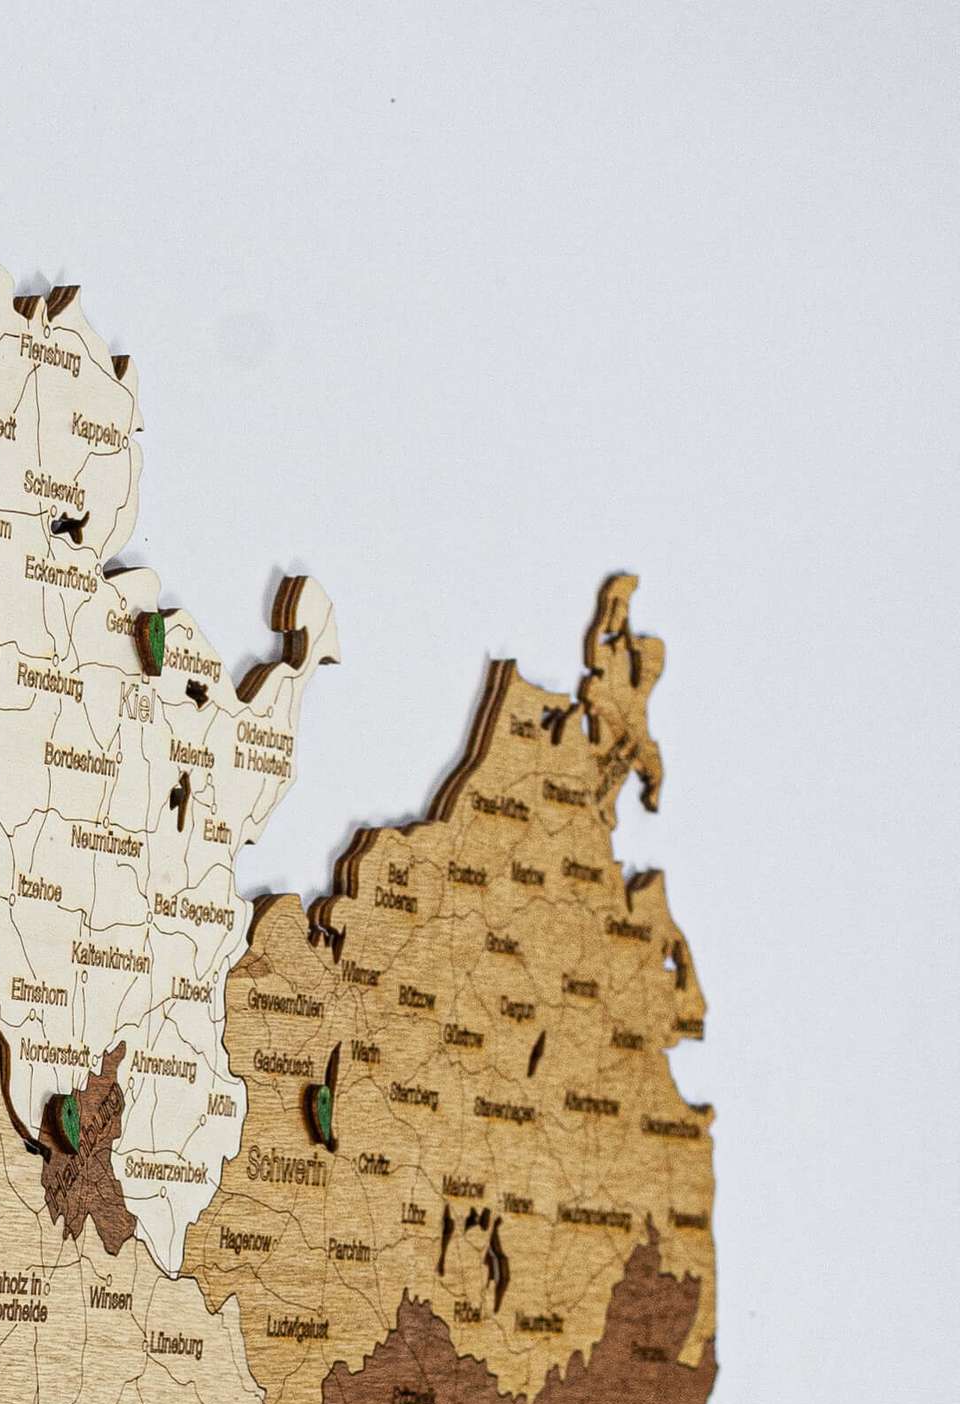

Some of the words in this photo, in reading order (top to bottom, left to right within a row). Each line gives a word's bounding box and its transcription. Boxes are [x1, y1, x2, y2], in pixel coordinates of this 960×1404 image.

[20, 333, 81, 377] Flensburg
[72, 412, 120, 449] Kappeln
[24, 469, 85, 509] Schleswig
[17, 663, 83, 702] Rendsburg
[119, 682, 155, 724] Kiel
[237, 721, 294, 756] Oldenburg
[44, 742, 116, 777] Bordesholm
[170, 740, 215, 768] Malente
[234, 750, 244, 768] in
[246, 752, 291, 778] Holstein
[71, 826, 143, 858] Neumünster
[204, 820, 231, 845] Eutin
[18, 874, 62, 902] Itzehoe
[154, 894, 177, 916] Bad
[180, 896, 234, 931] Segeberg
[71, 941, 150, 974] Kaltenkirchen
[11, 977, 67, 1007] Elmshorn
[171, 977, 212, 1003] Lübeck
[20, 1039, 90, 1067] Norderstedt
[131, 1051, 197, 1084] Ahrensburg
[207, 1094, 237, 1118] Mölln
[124, 1156, 208, 1184] Schwarzenbek
[247, 1146, 327, 1187] Schwerin
[220, 1228, 271, 1252] Hagenow
[30, 1270, 41, 1295] in
[90, 1286, 132, 1311] Winsen
[150, 1329, 203, 1359] Lüneburg
